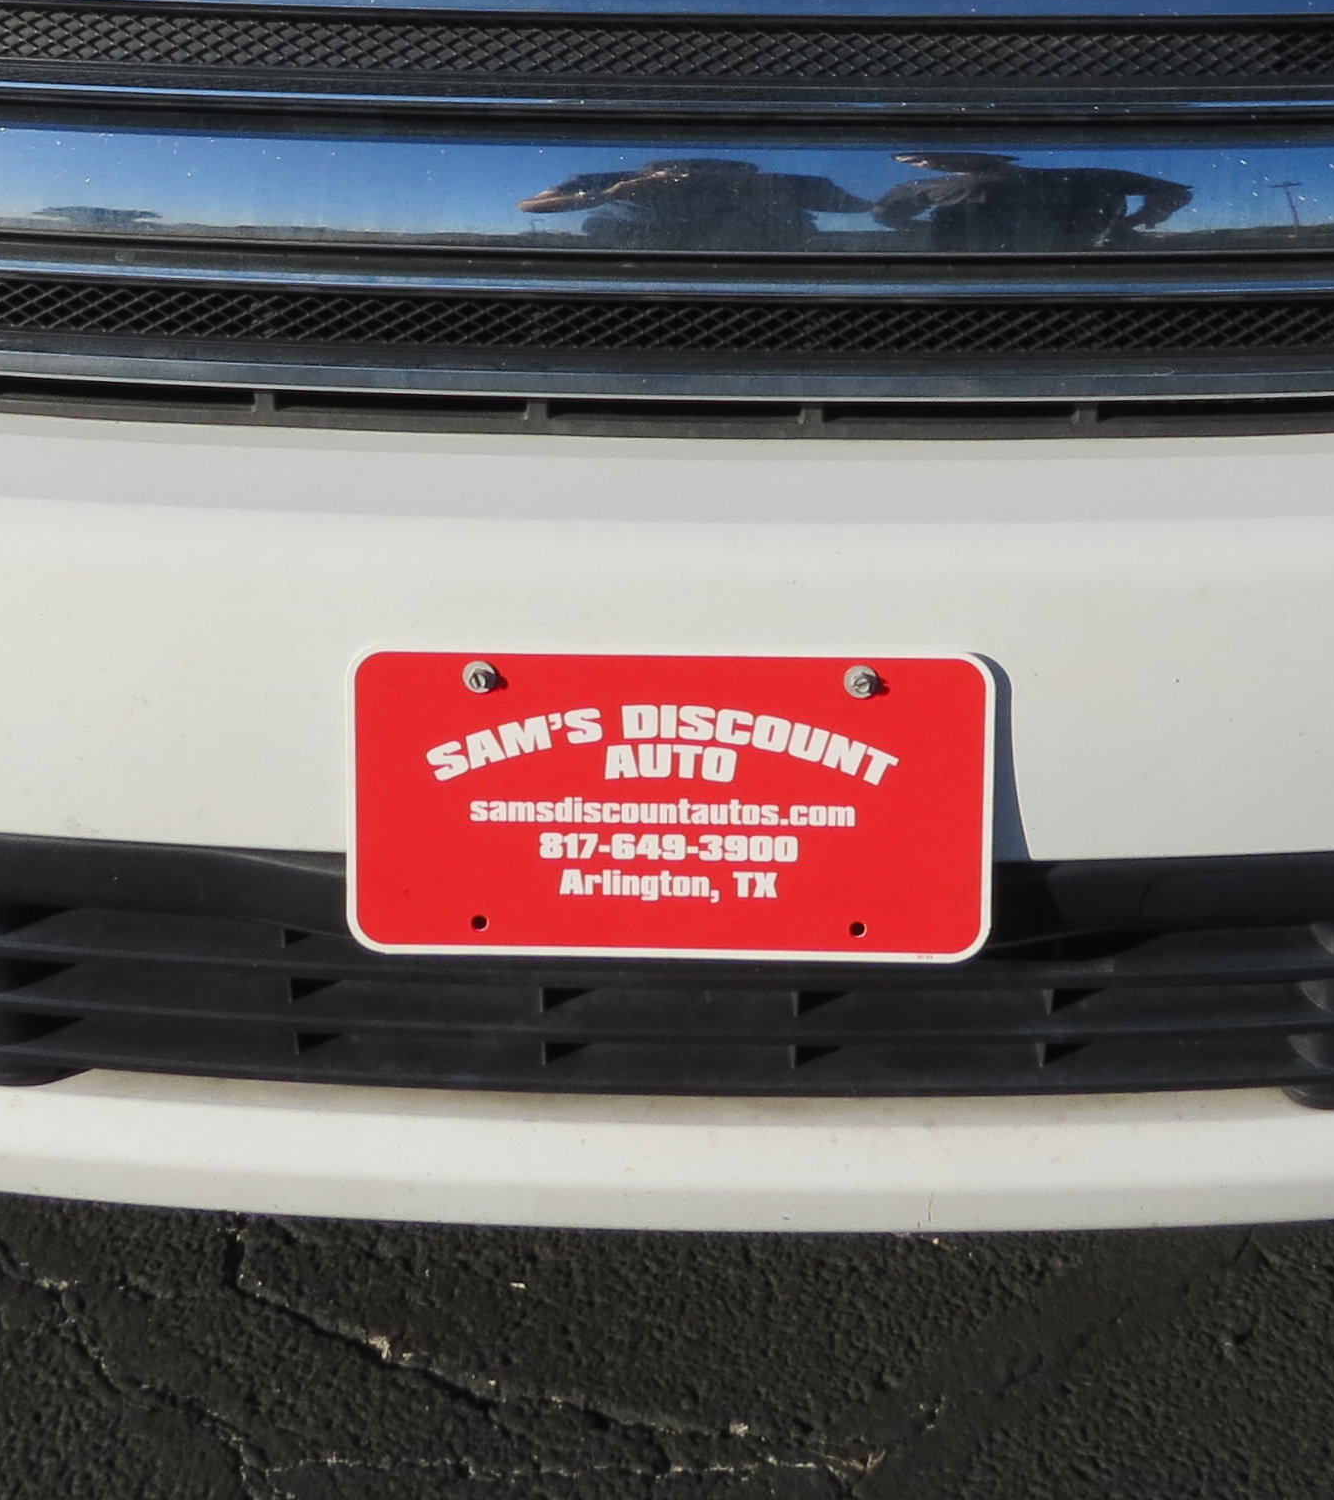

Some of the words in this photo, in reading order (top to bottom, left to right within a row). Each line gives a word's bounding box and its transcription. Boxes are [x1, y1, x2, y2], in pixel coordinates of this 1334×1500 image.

[425, 707, 603, 782] SAM'S
[621, 704, 900, 786] DISCOUNT
[604, 743, 738, 783] AUTO
[469, 796, 856, 828] samsdiscountautos.com
[539, 832, 799, 863] 817-649-3900
[559, 868, 720, 904] Arlington,
[732, 871, 778, 899] TX
